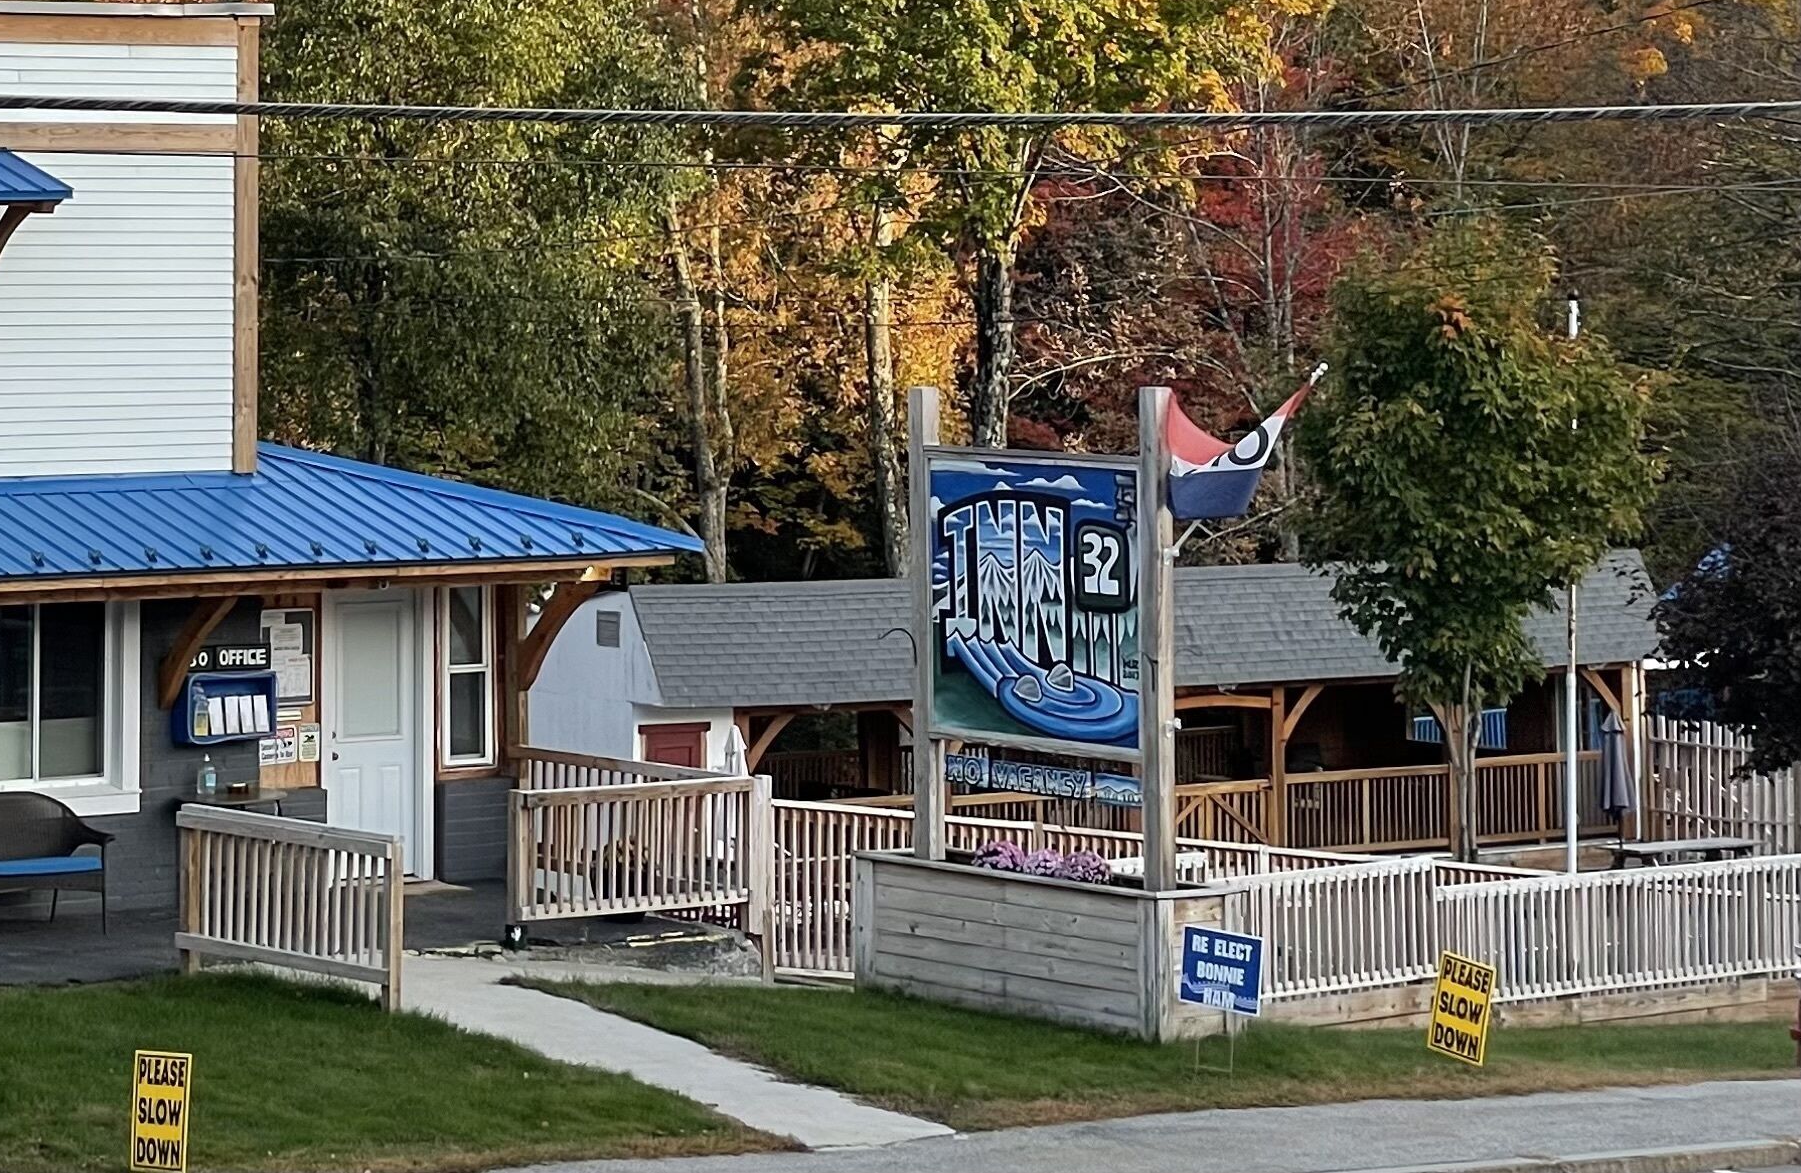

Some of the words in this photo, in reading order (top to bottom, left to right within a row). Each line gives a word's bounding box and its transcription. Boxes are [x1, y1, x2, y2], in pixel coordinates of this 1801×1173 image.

[1082, 532, 1119, 595] 32
[943, 499, 1066, 664] INN
[219, 648, 267, 666] OFFICE
[947, 755, 983, 785] NO
[991, 761, 1086, 798] VACANCY
[1191, 934, 1210, 954] RE
[1214, 938, 1253, 962] ELECT
[1196, 960, 1245, 986] BONNIE
[1443, 958, 1490, 994] PLEASE
[1203, 987, 1237, 1009] HAM
[1439, 991, 1484, 1025] SLOW
[1433, 1022, 1479, 1058] DOWN
[138, 1058, 186, 1087] PLEASE
[138, 1097, 182, 1126] SLOW
[136, 1136, 181, 1166] DOWN
